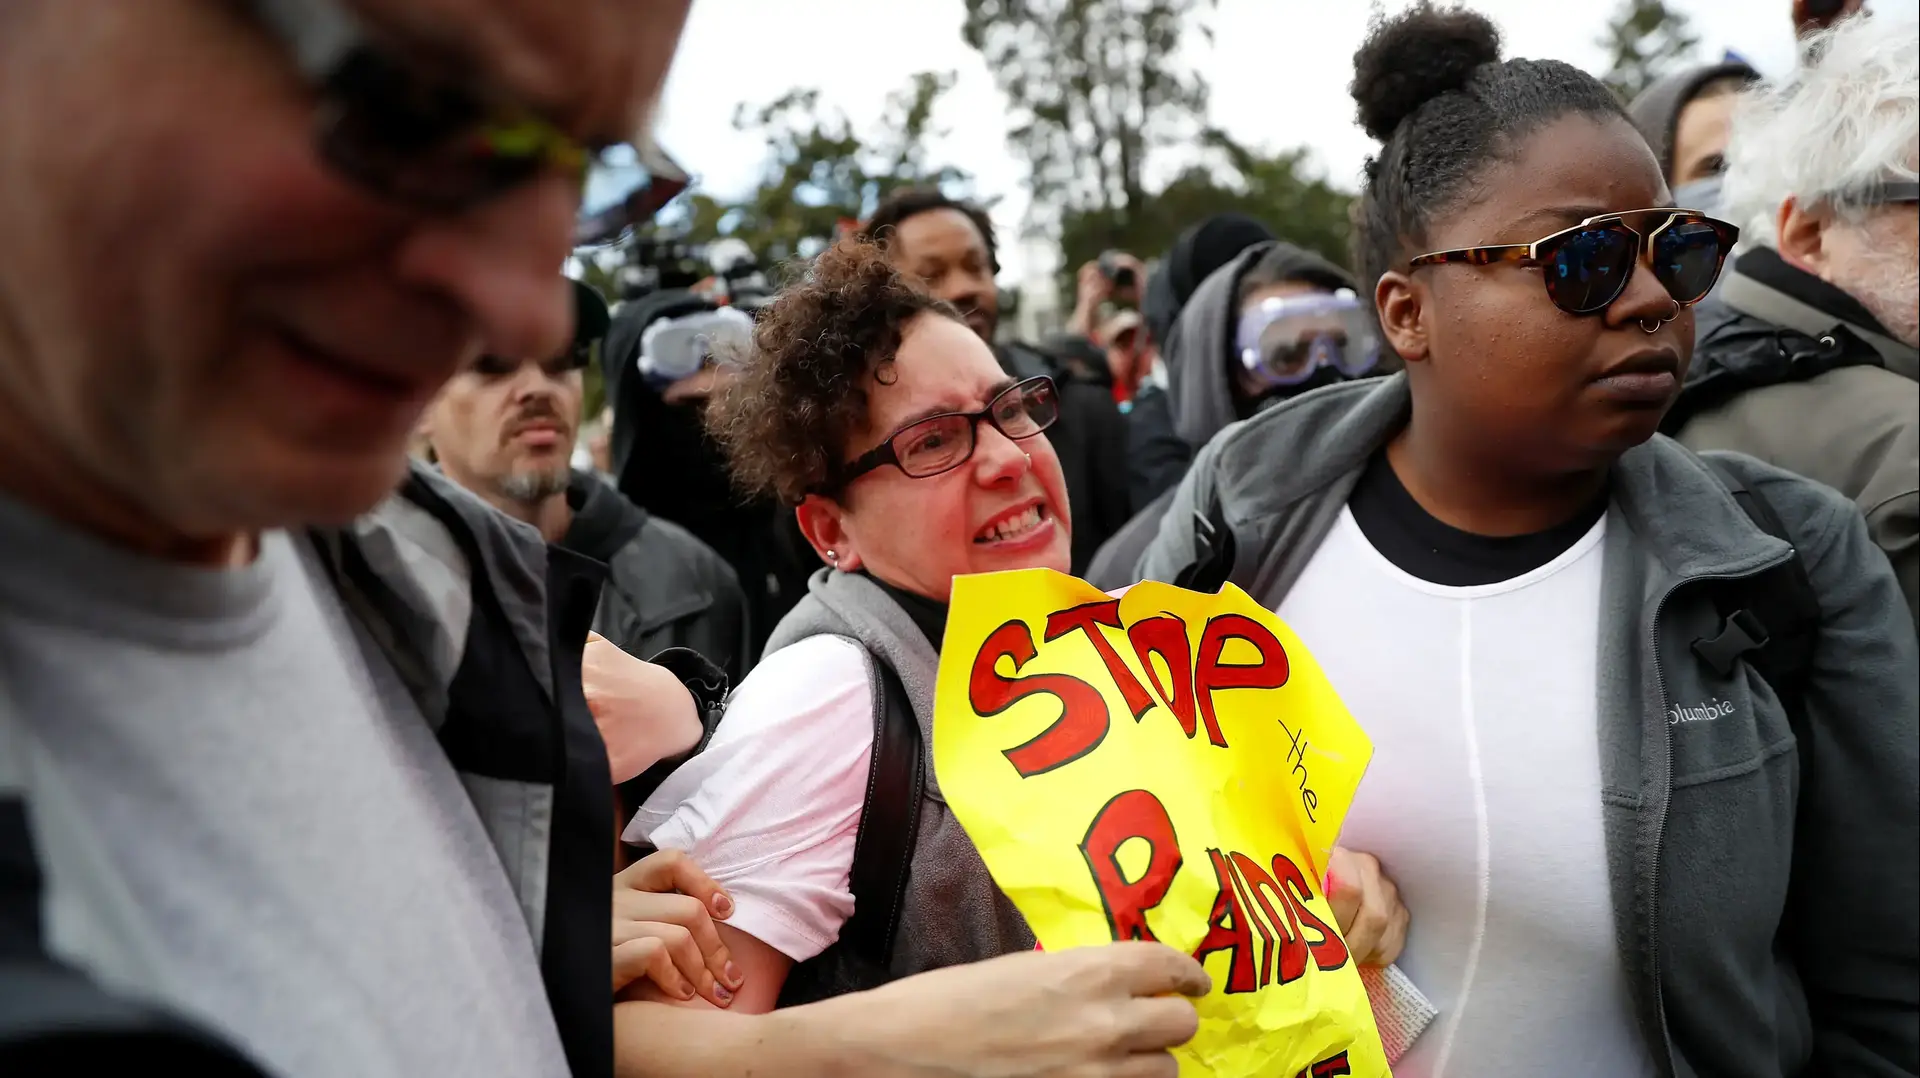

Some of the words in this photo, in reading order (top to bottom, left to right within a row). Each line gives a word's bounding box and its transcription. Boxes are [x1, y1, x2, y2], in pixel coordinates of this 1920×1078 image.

[968, 599, 1289, 778] STOP
[1667, 697, 1736, 725] olumbia
[1277, 719, 1318, 823] the
[1077, 788, 1350, 994] RAIDS
